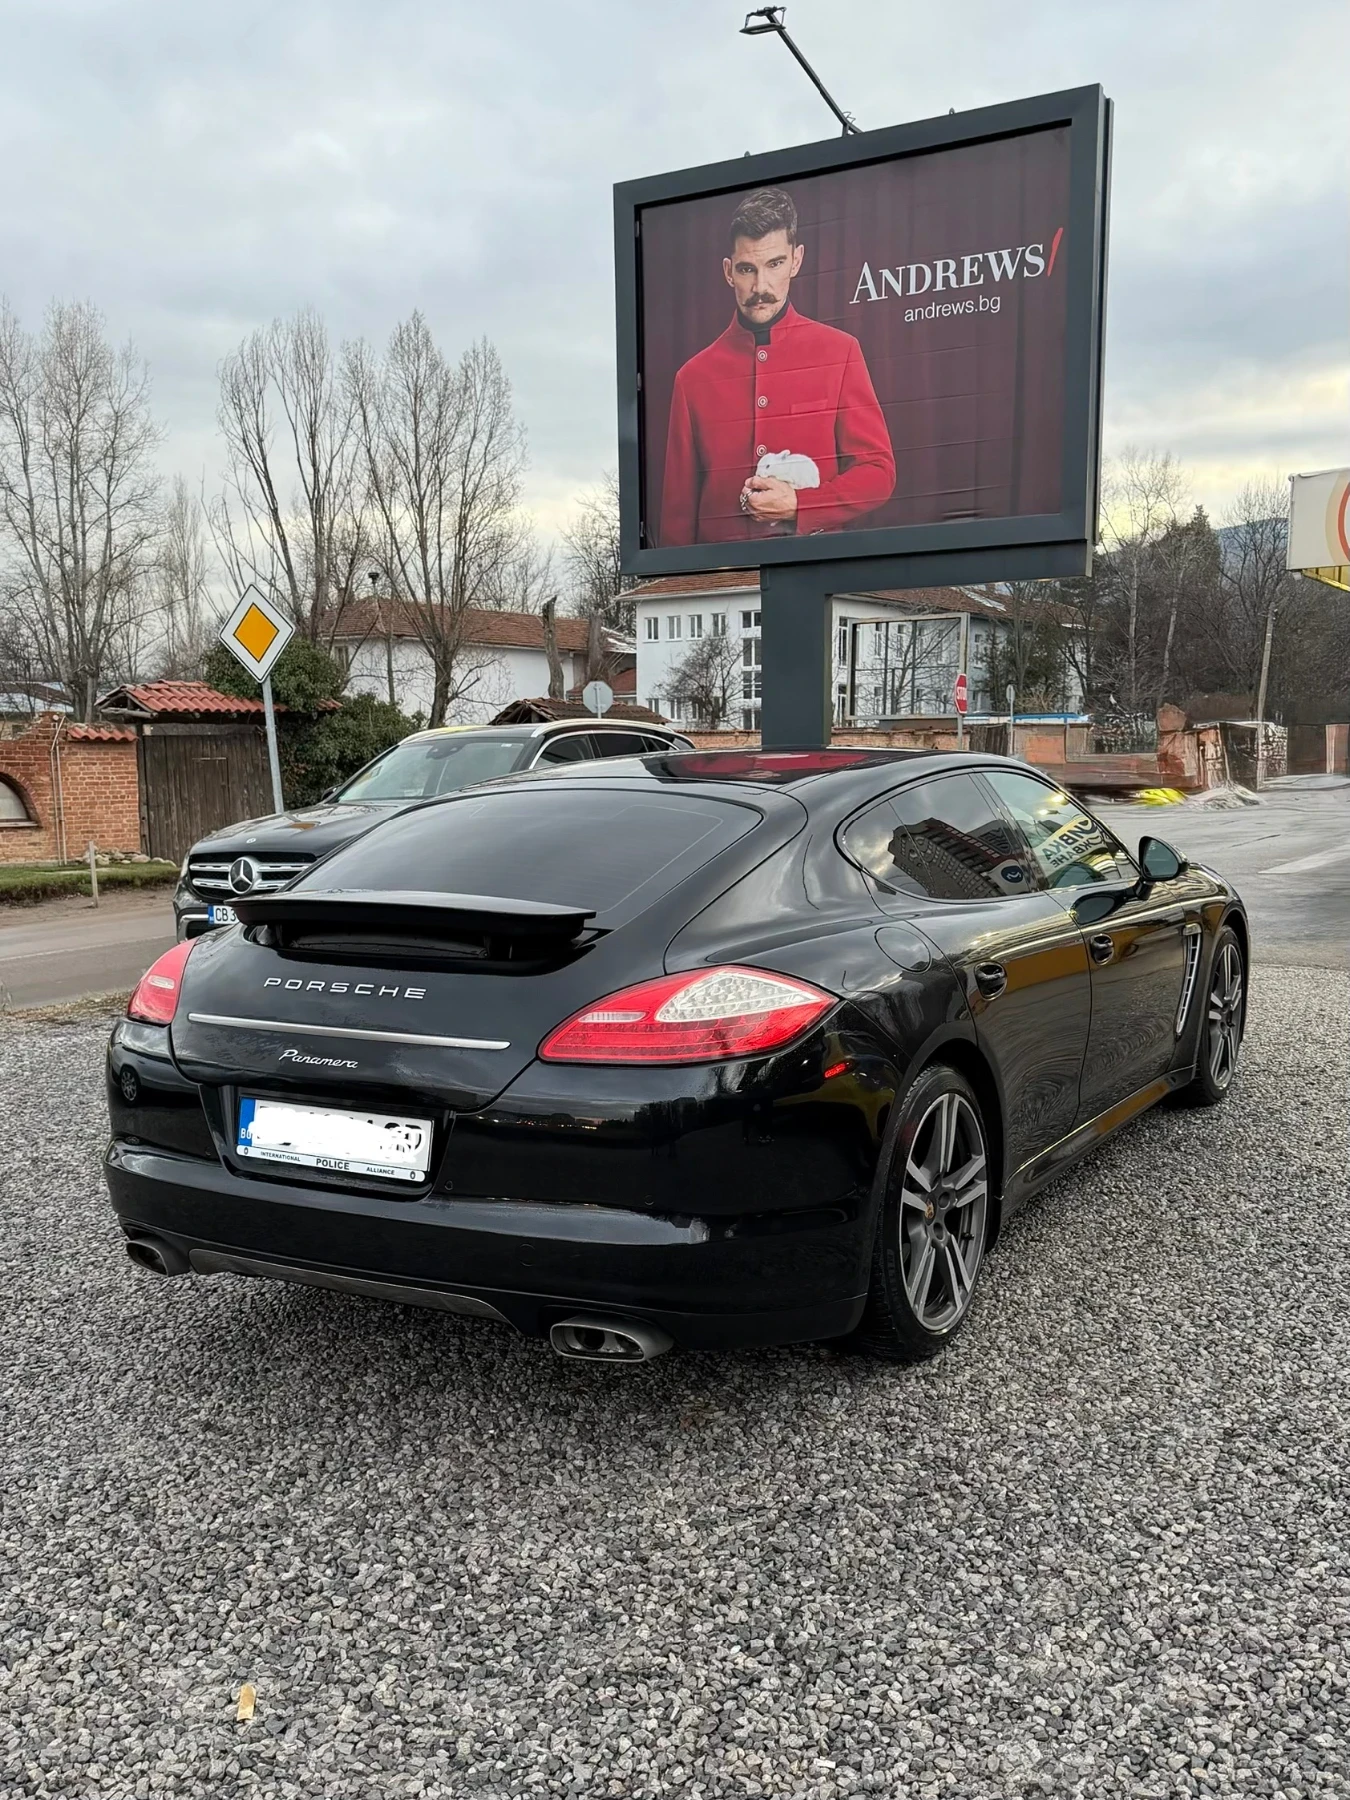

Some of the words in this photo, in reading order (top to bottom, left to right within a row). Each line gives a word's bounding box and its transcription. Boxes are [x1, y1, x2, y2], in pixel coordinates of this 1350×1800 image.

[904, 295, 1001, 322] andrews.bg
[215, 907, 228, 921] CB
[263, 977, 427, 999] PORSCHE
[279, 1049, 360, 1068] Panamera
[260, 1151, 301, 1162] INTERNATIONAL
[316, 1158, 350, 1171] POLICE
[366, 1166, 395, 1176] ALLIANCE
